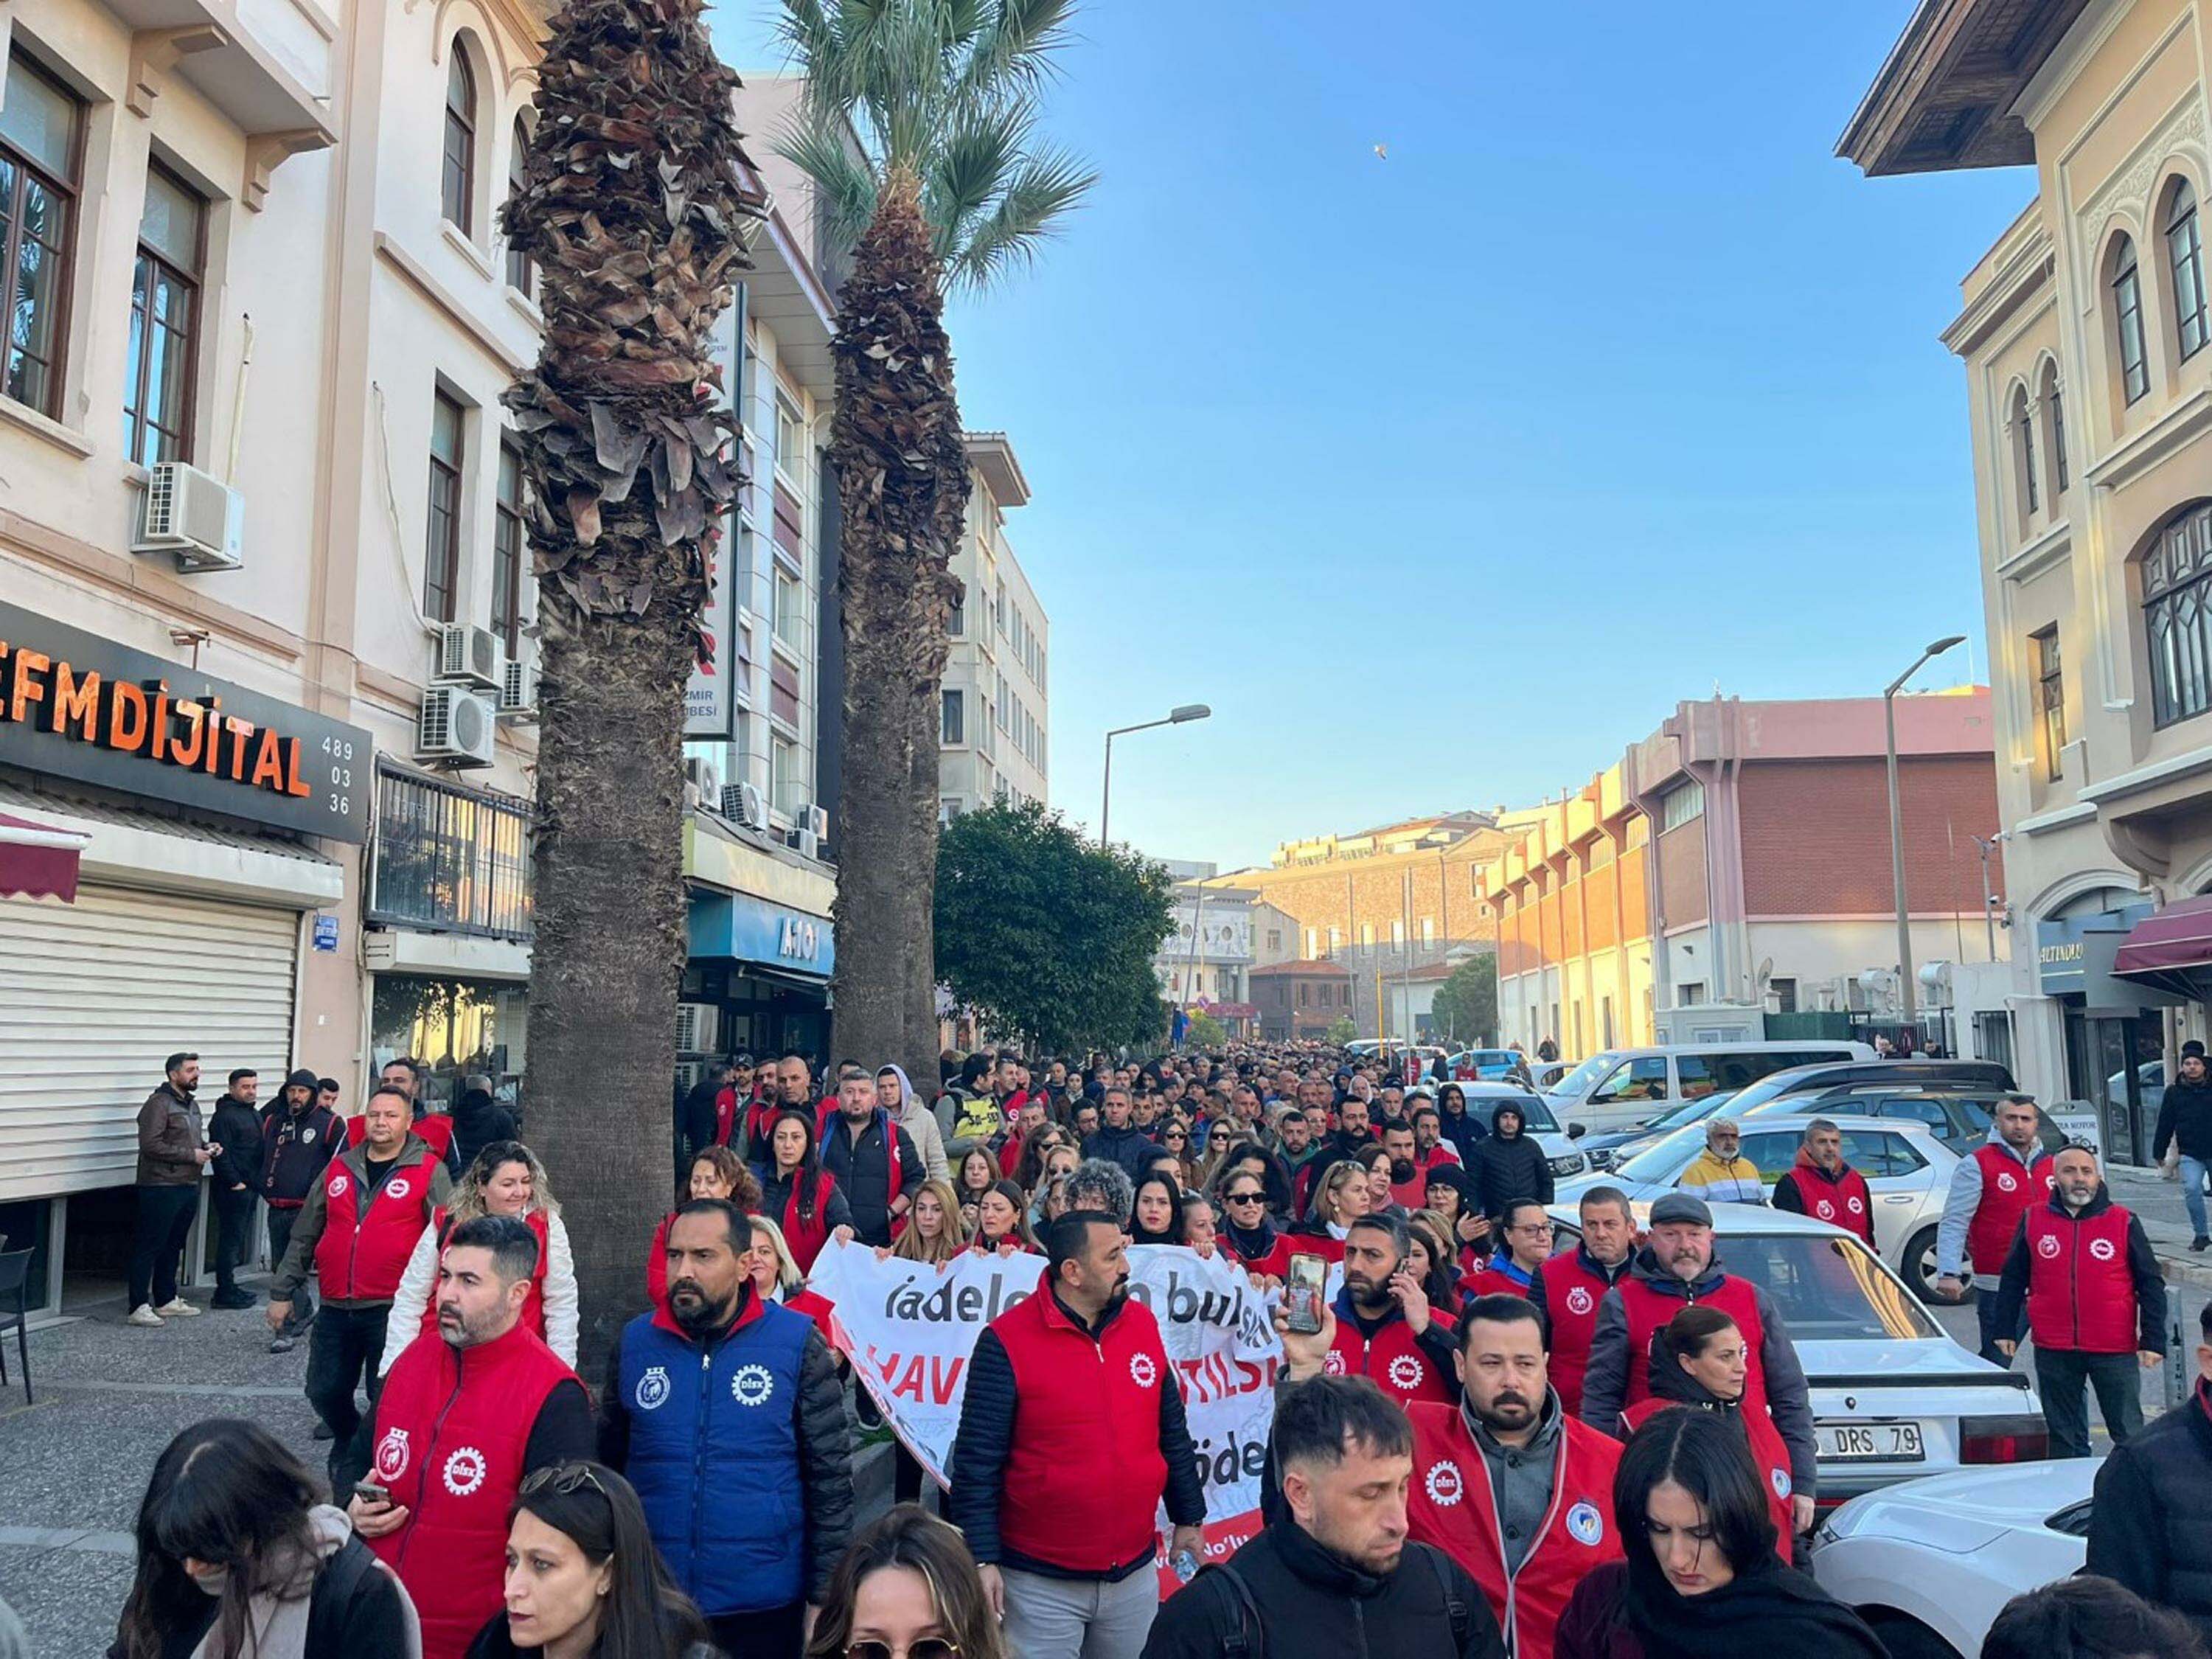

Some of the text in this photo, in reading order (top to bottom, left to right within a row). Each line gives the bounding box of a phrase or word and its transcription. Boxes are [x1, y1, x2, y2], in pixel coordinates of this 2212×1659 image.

[110, 679, 310, 798] DİJİTAL
[322, 736, 352, 760] 489
[331, 767, 350, 788] 03
[330, 793, 349, 814] 36
[1835, 1428, 1874, 1453] DRS
[1891, 1427, 1916, 1451] 79
